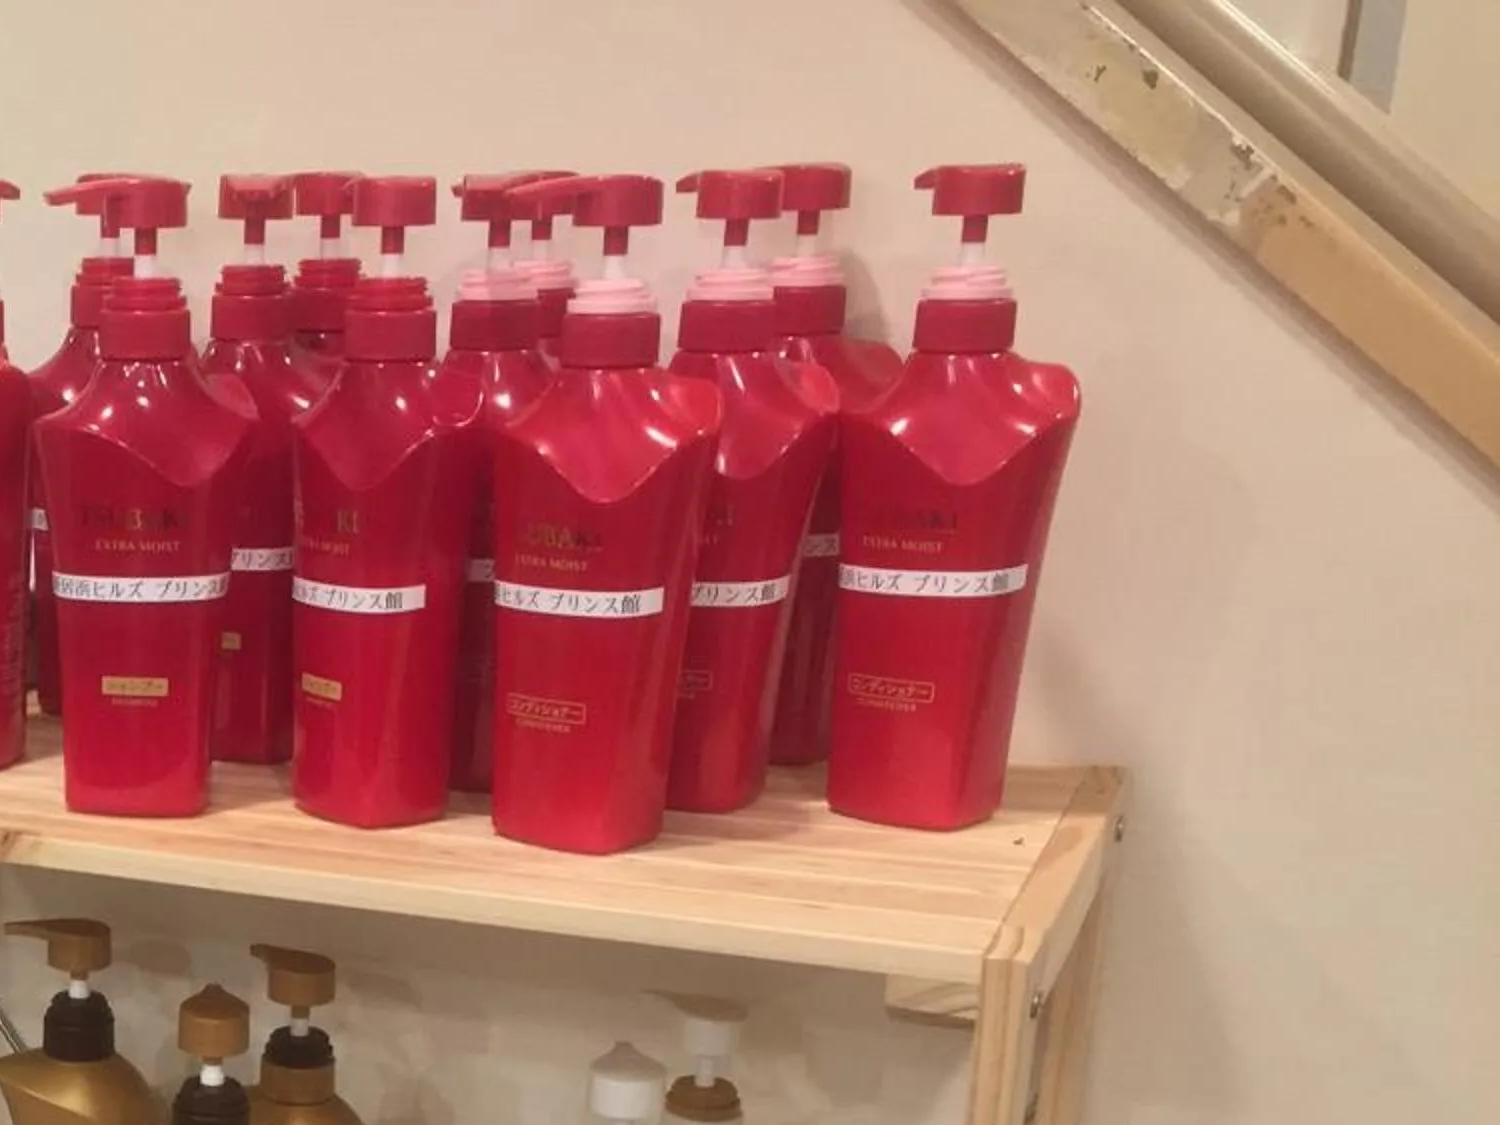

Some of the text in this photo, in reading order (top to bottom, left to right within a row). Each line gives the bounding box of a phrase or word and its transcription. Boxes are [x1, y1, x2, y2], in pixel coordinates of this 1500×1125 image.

[914, 573, 1010, 594] プリンス館
[328, 587, 403, 610] プリンス館
[549, 592, 642, 615] プリンス館
